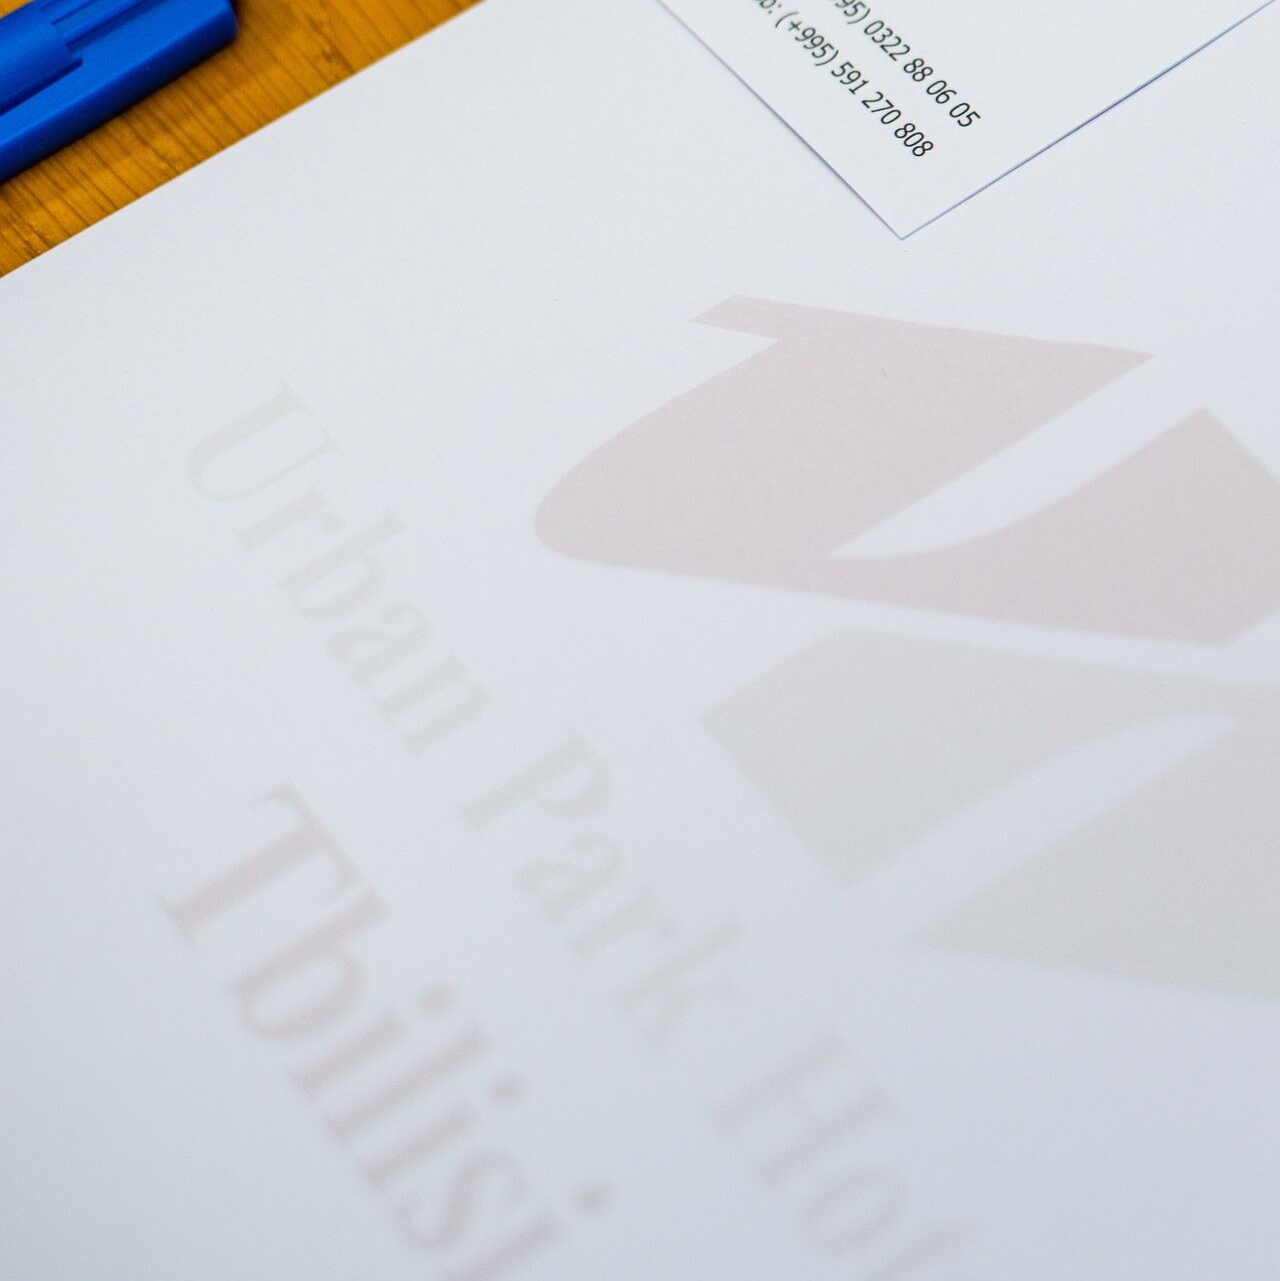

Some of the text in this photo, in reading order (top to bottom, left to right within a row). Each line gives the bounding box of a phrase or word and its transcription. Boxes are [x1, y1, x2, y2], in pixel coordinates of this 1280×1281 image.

[775, 11, 839, 67] (+995)
[831, 61, 870, 95] 591
[861, 91, 901, 125] 270
[894, 122, 934, 157] 808
[863, 20, 910, 61] 0322
[903, 57, 934, 82] 88
[926, 80, 957, 105] 06
[950, 102, 981, 127] 05
[184, 379, 496, 759] Urban
[456, 716, 749, 1060] Park
[153, 778, 617, 1281] Tbilisi
